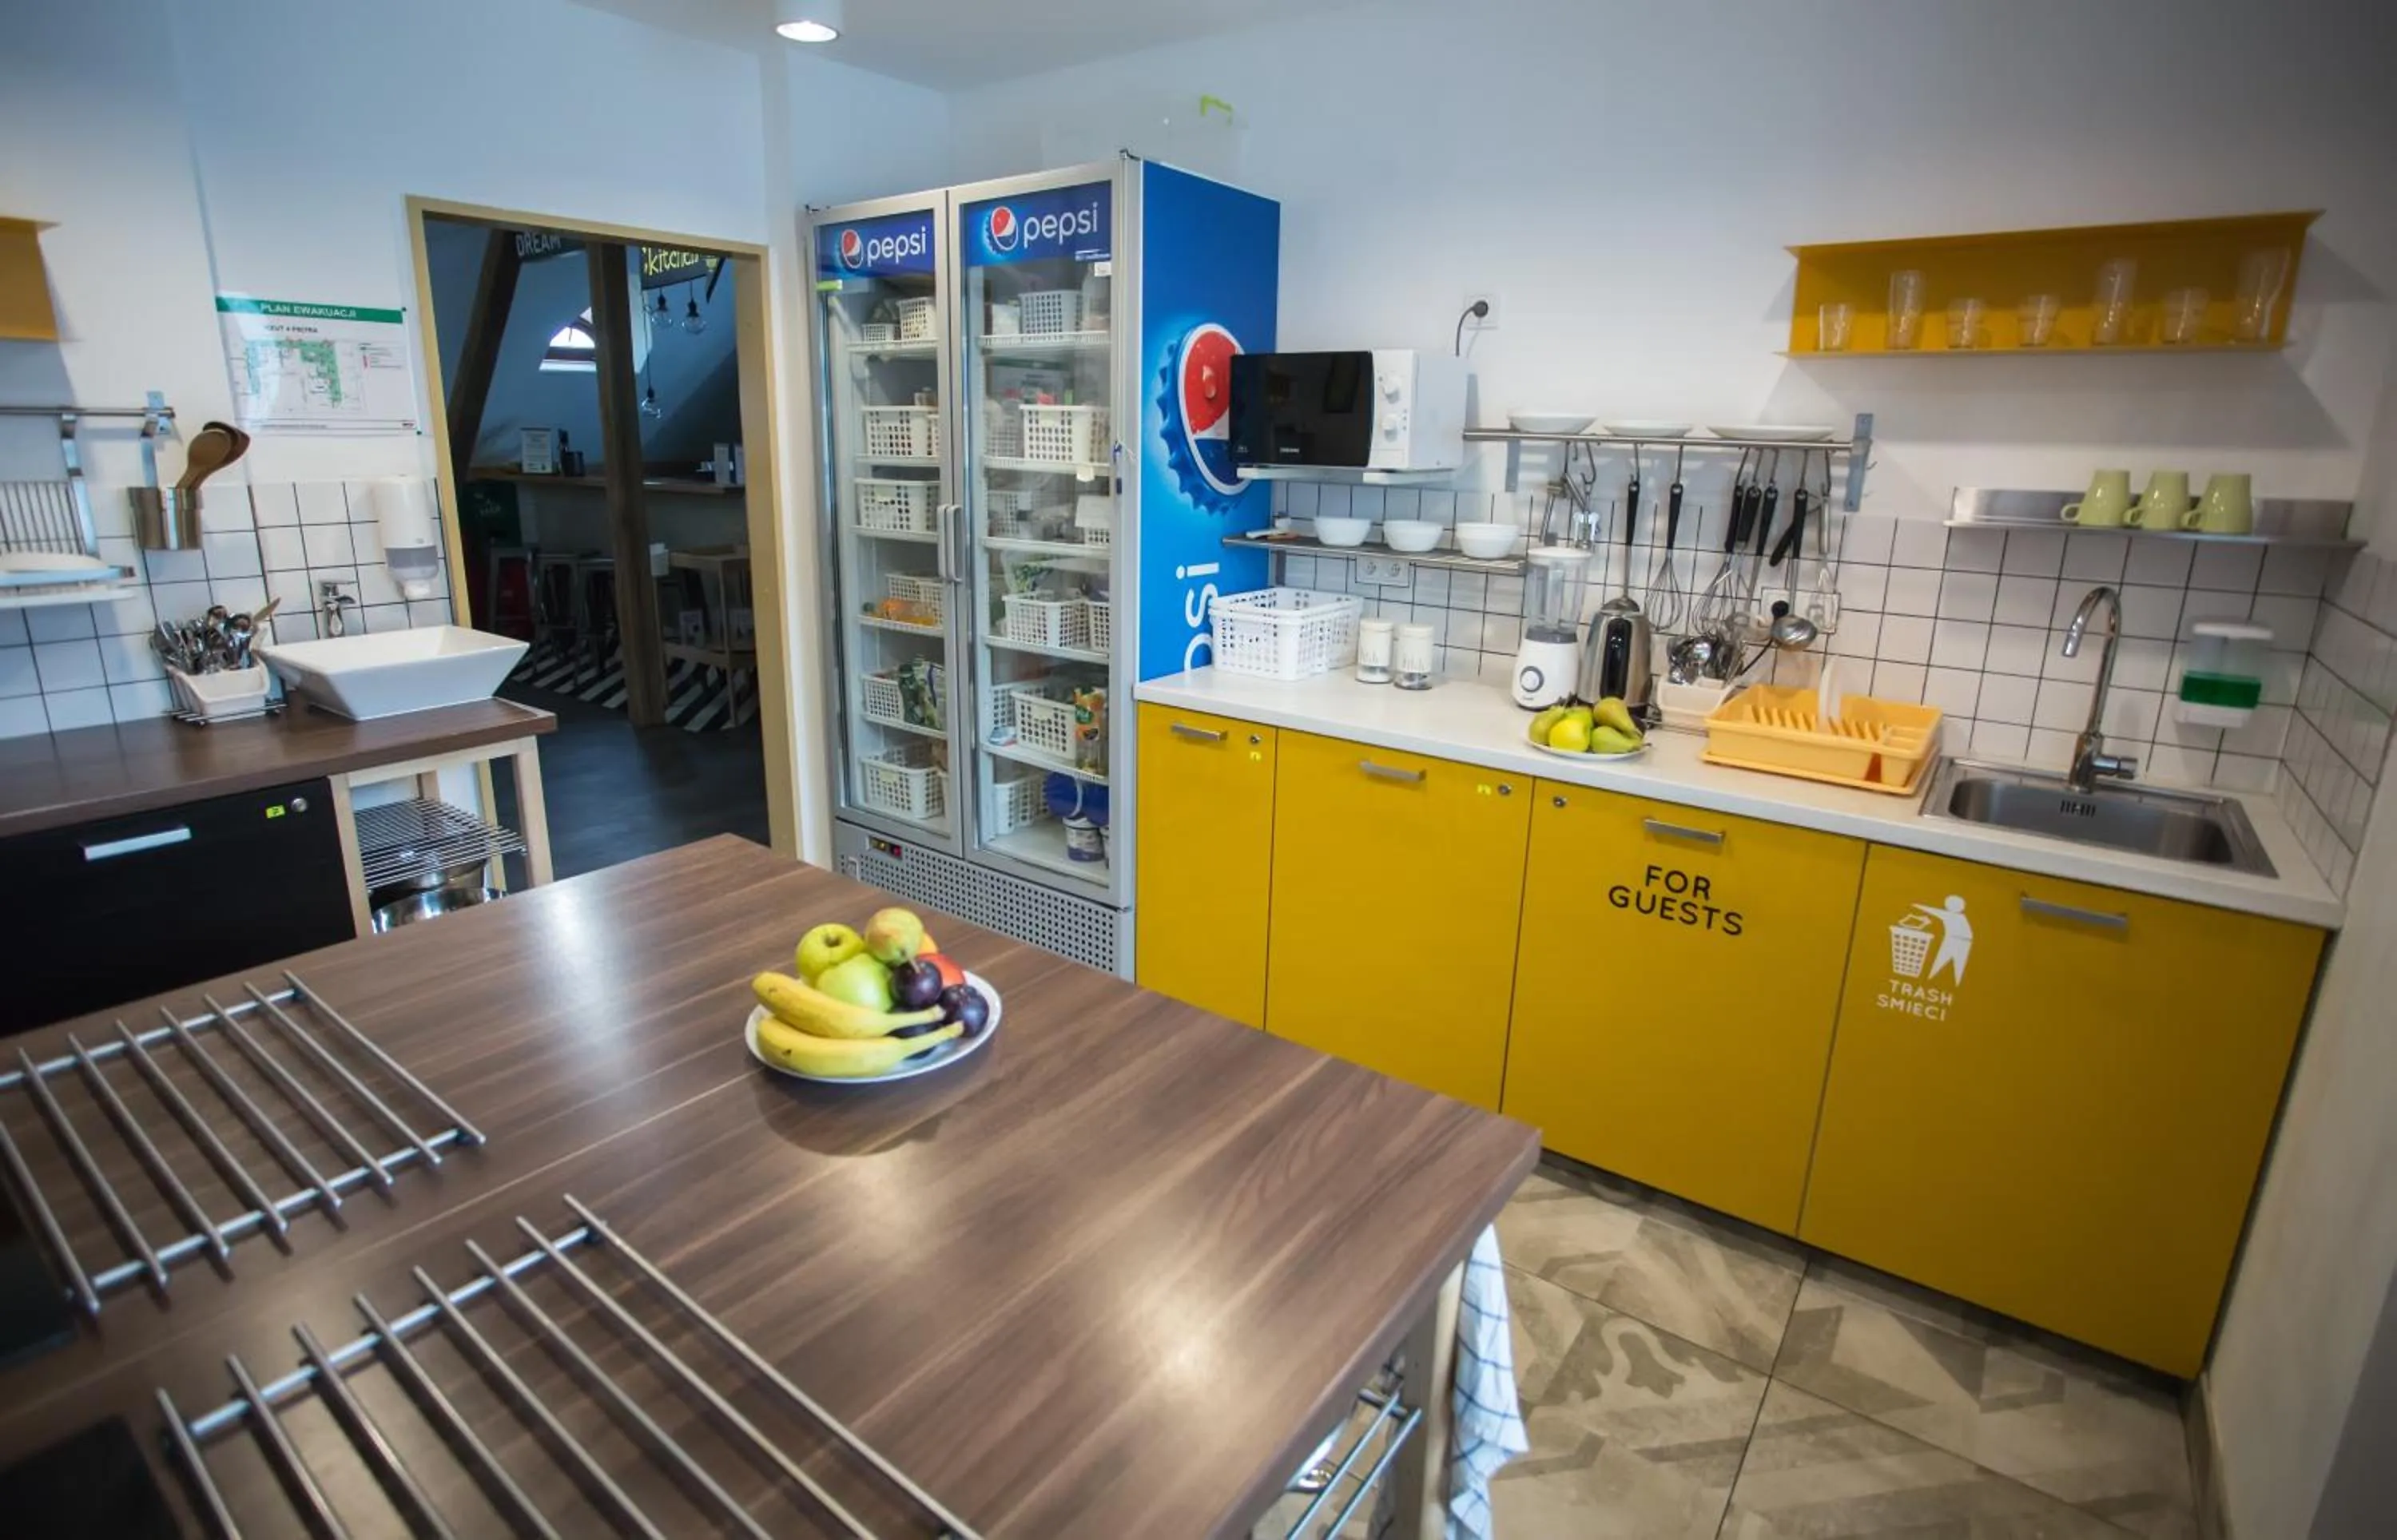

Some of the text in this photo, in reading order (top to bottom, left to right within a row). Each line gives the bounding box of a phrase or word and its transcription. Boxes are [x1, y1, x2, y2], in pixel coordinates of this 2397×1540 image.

[1024, 202, 1099, 248] pepsi
[515, 230, 562, 256] DREAM
[867, 226, 927, 267] pepsi
[260, 303, 357, 318] PLAN EWAKUACJI
[1645, 864, 1711, 901] FOR
[1608, 885, 1743, 936] GUESTS
[1876, 994, 1946, 1022] SMIECI
[1889, 978, 1953, 1006] TRASH
